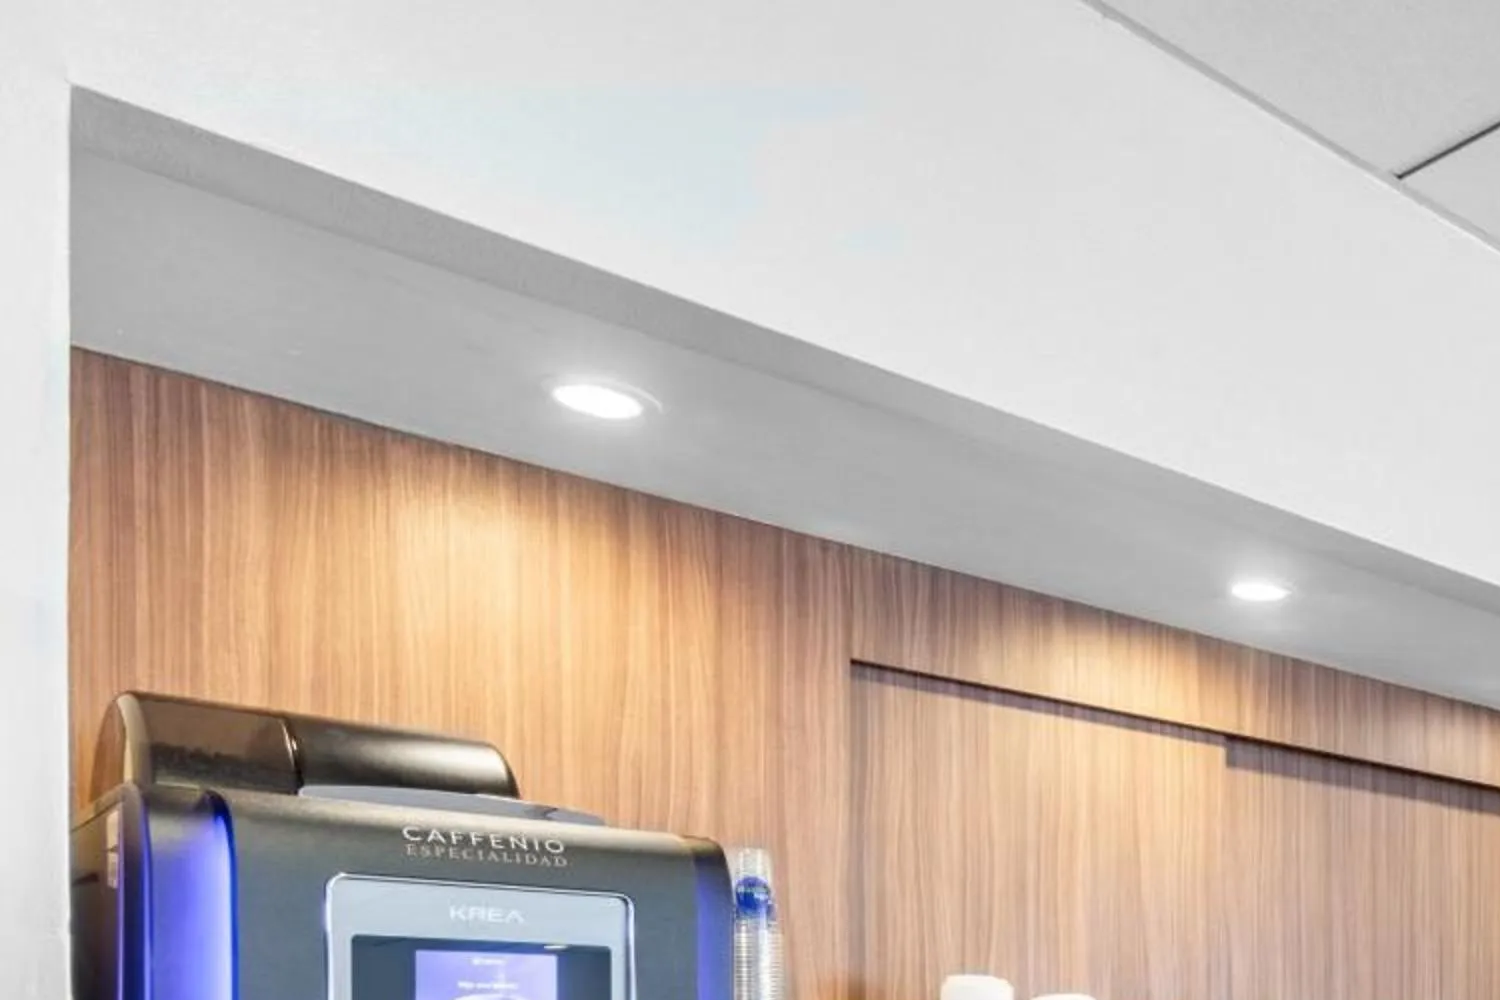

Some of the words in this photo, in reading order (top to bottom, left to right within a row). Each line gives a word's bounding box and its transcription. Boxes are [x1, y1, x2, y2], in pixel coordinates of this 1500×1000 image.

[402, 826, 565, 854] CAFFENIO
[405, 843, 569, 868] ESPECIALIDAD
[449, 904, 525, 924] KREA
